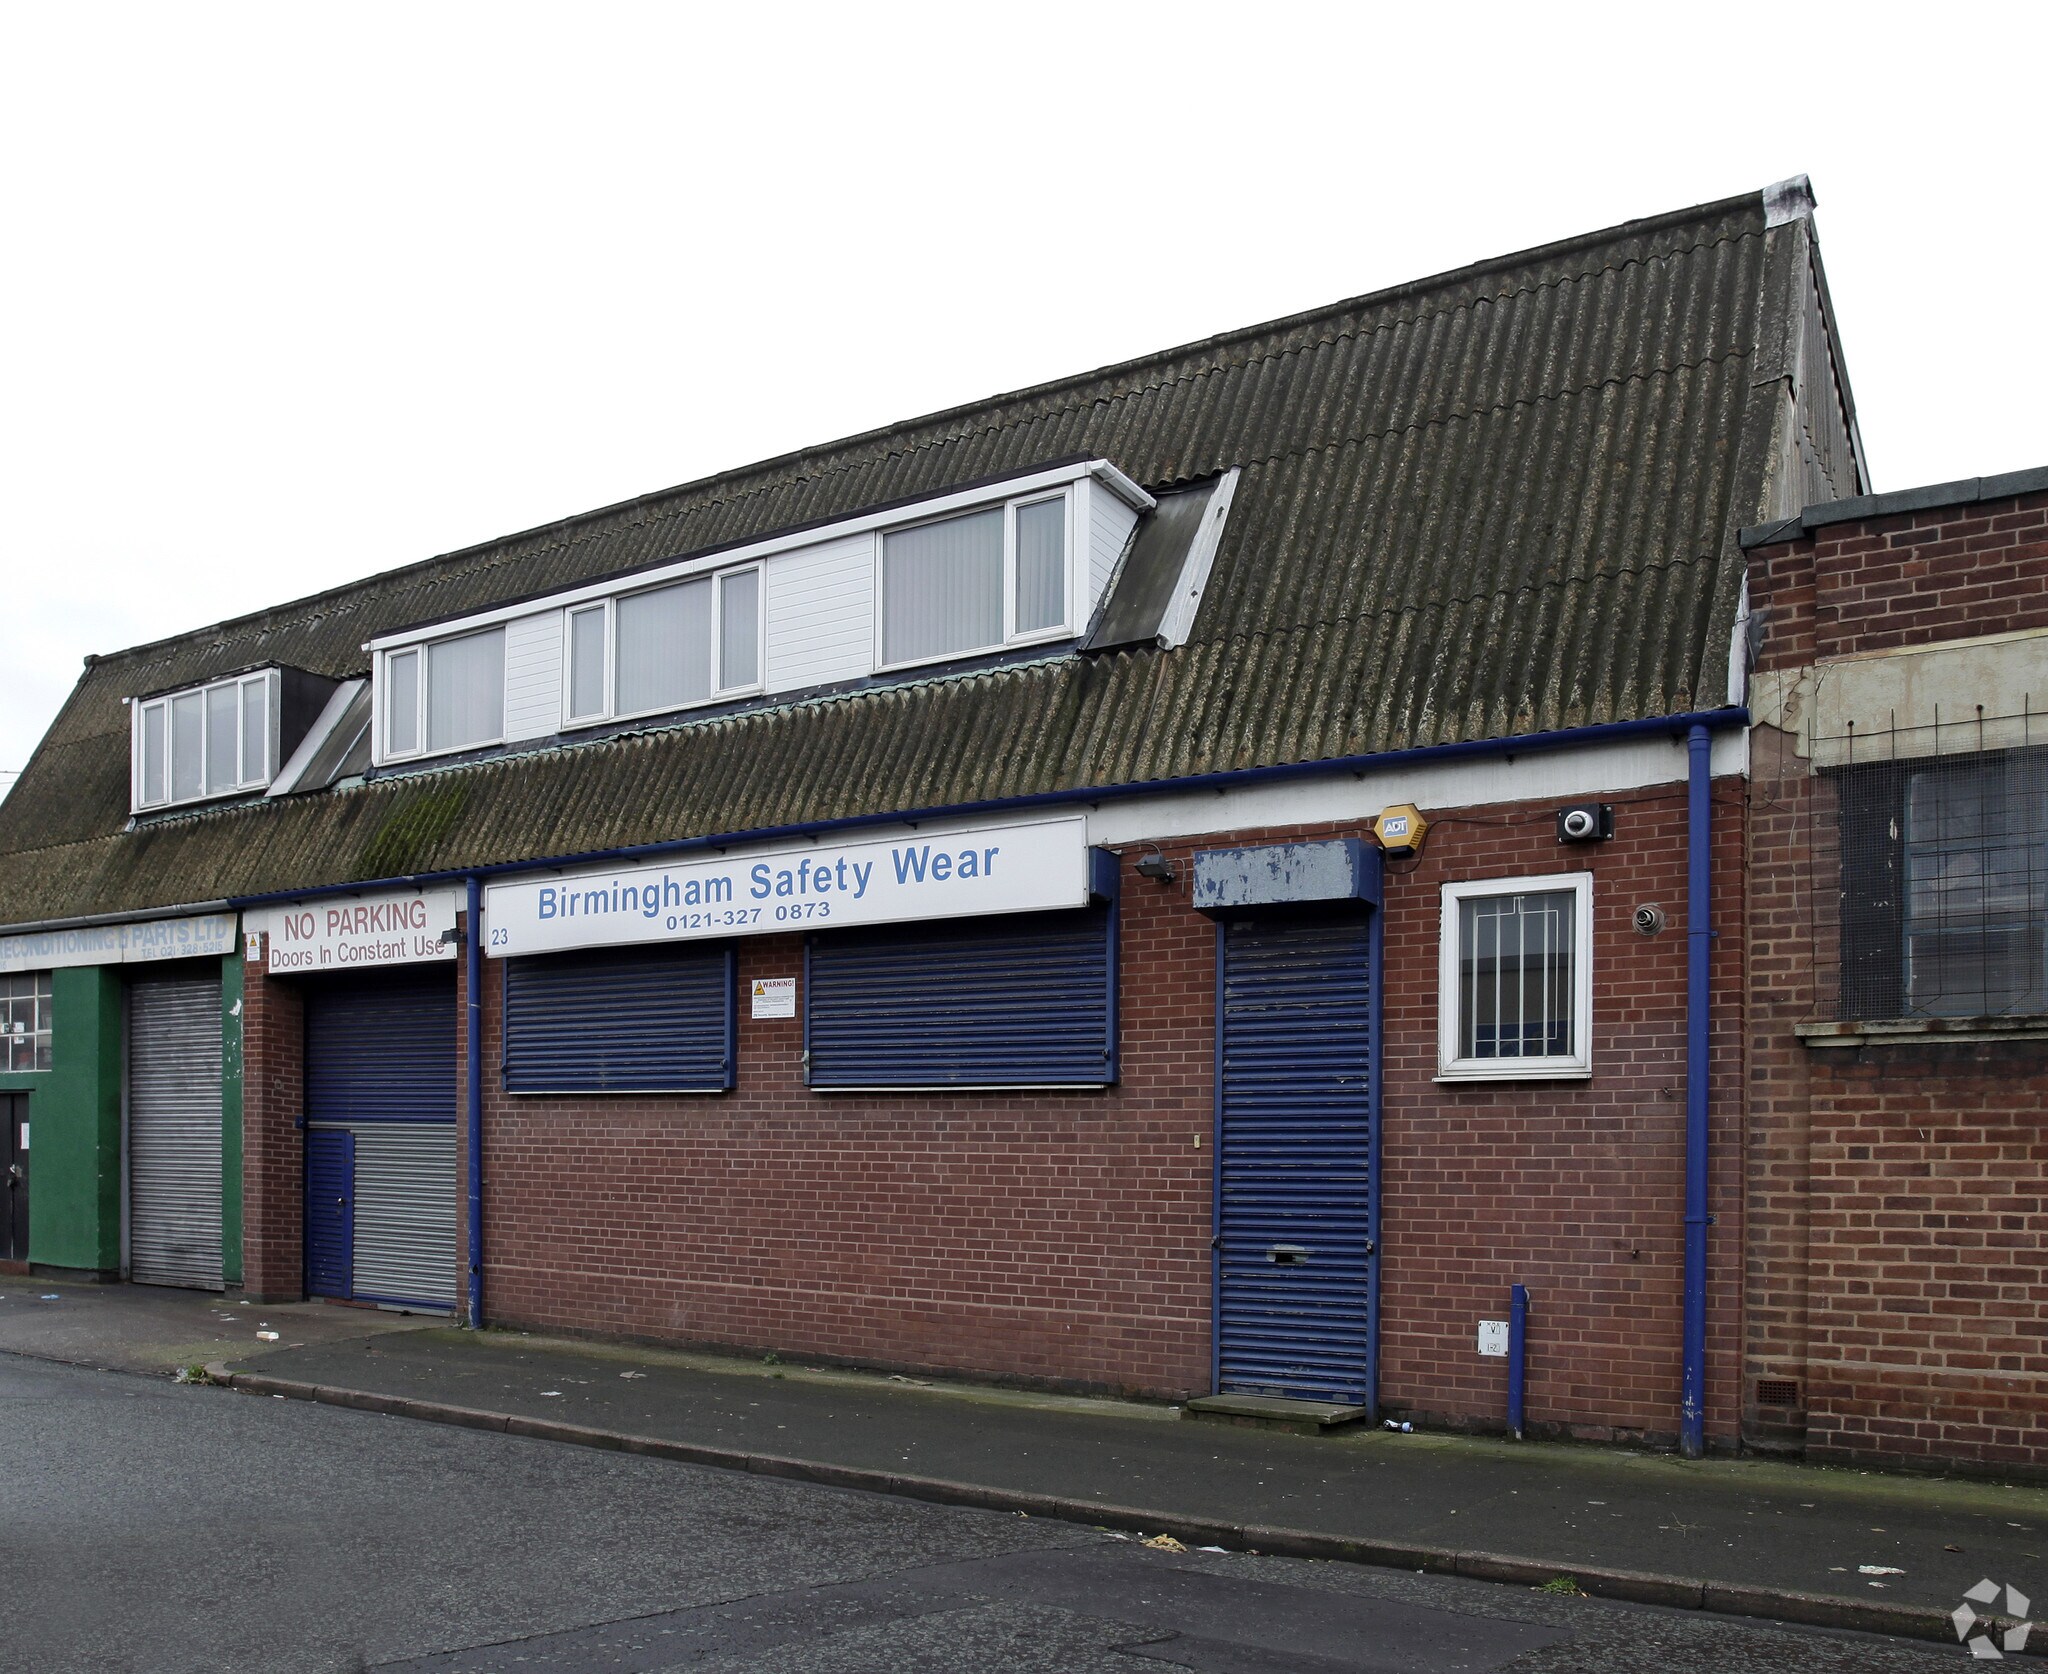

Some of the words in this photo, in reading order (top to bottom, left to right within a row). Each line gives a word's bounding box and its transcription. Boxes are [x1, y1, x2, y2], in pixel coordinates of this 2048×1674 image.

[1384, 820, 1407, 833] ADT
[538, 875, 733, 919] Birmingham
[750, 856, 874, 899] Safety
[892, 845, 1000, 884] Wear
[284, 912, 315, 941] NO
[326, 900, 427, 937] PARKING
[666, 908, 762, 930] 0121-327
[775, 901, 831, 921] 0873
[131, 920, 190, 948] PARTS
[194, 917, 228, 942] LTD
[491, 928, 508, 945] 23
[141, 947, 158, 959] TEL
[271, 948, 313, 968] Doors
[320, 945, 332, 964] In
[338, 939, 407, 962] Constant
[414, 935, 445, 956] Use
